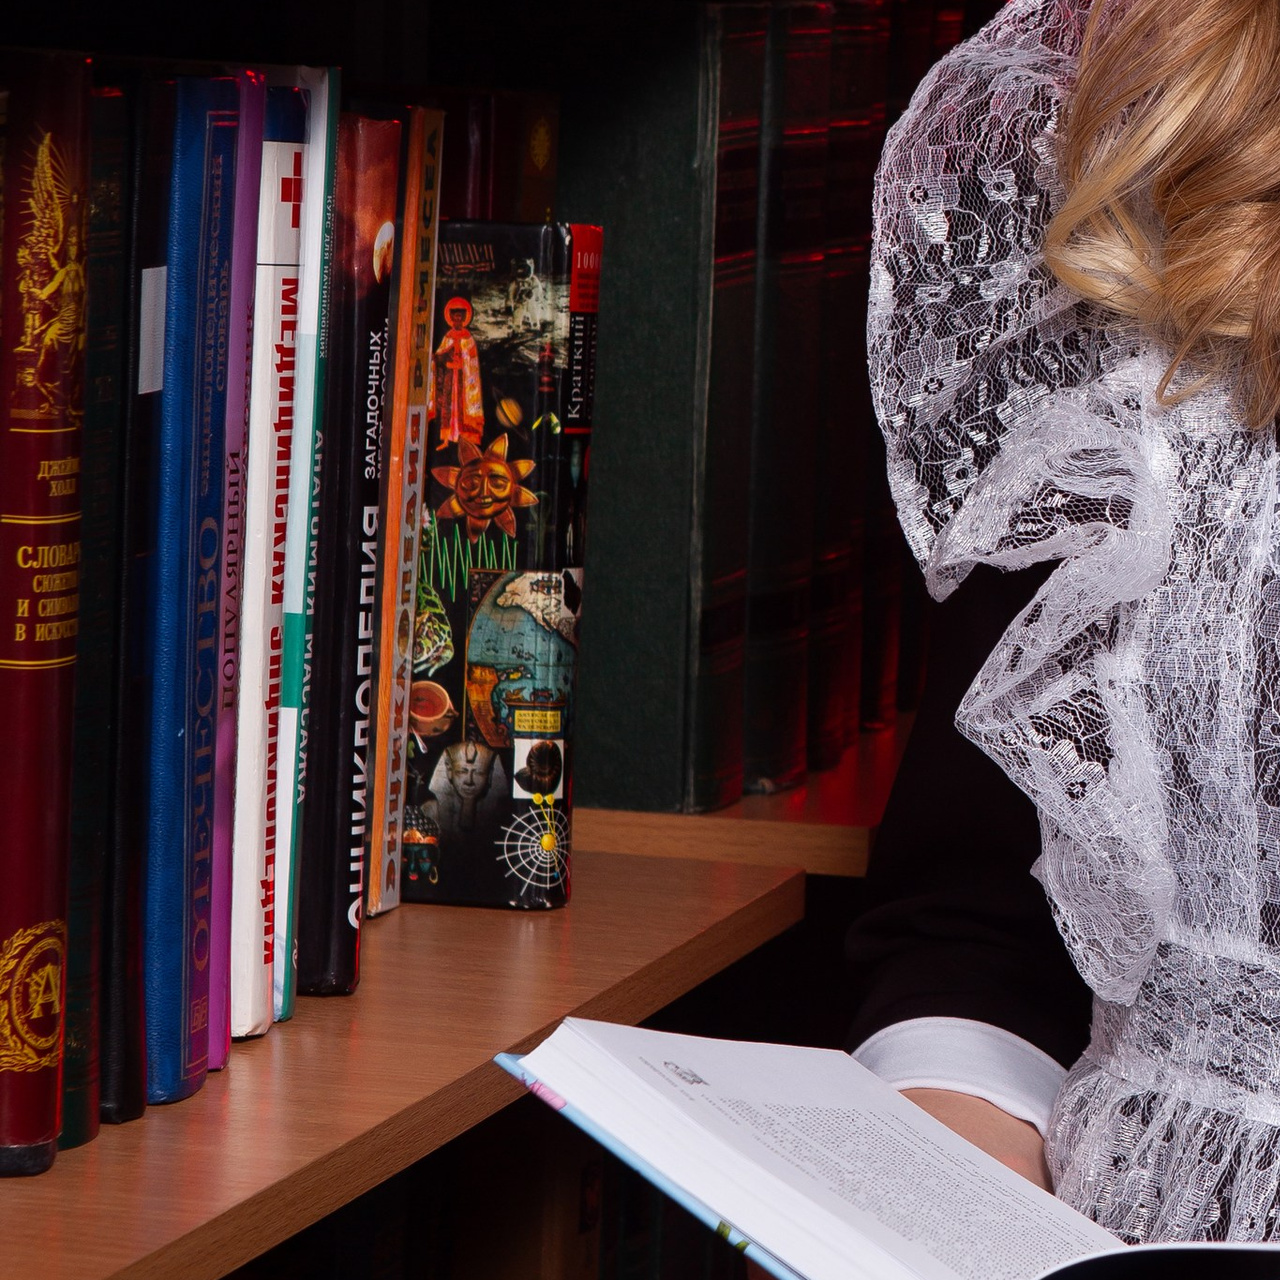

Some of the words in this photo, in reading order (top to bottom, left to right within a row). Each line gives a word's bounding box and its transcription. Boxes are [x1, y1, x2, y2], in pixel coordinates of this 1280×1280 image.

[200, 154, 223, 497] энциклопедический
[215, 259, 229, 393] словарь
[319, 265, 329, 359] НАЧИНАЮЩИХ
[364, 330, 382, 480] ЗАГАДОЧНЫХ
[567, 315, 585, 419] Краткий
[271, 277, 300, 606] МЕДИЦИНСКАЯ
[306, 429, 324, 616] АНАТОМИЯ
[14, 623, 27, 642] В
[16, 599, 30, 617] И
[222, 450, 240, 711] ПОПУЛЯРНЫЙ
[385, 411, 420, 892] ЭНЦИКЛОПЕДИЯ
[192, 516, 219, 972] ОТЕЧЕСТВО
[260, 626, 284, 965] ЭНЦИКЛОПЕДИЯ
[296, 633, 314, 805] МАССАЖА
[347, 505, 379, 930] ЭНЦИКЛОПЕДИЯ
